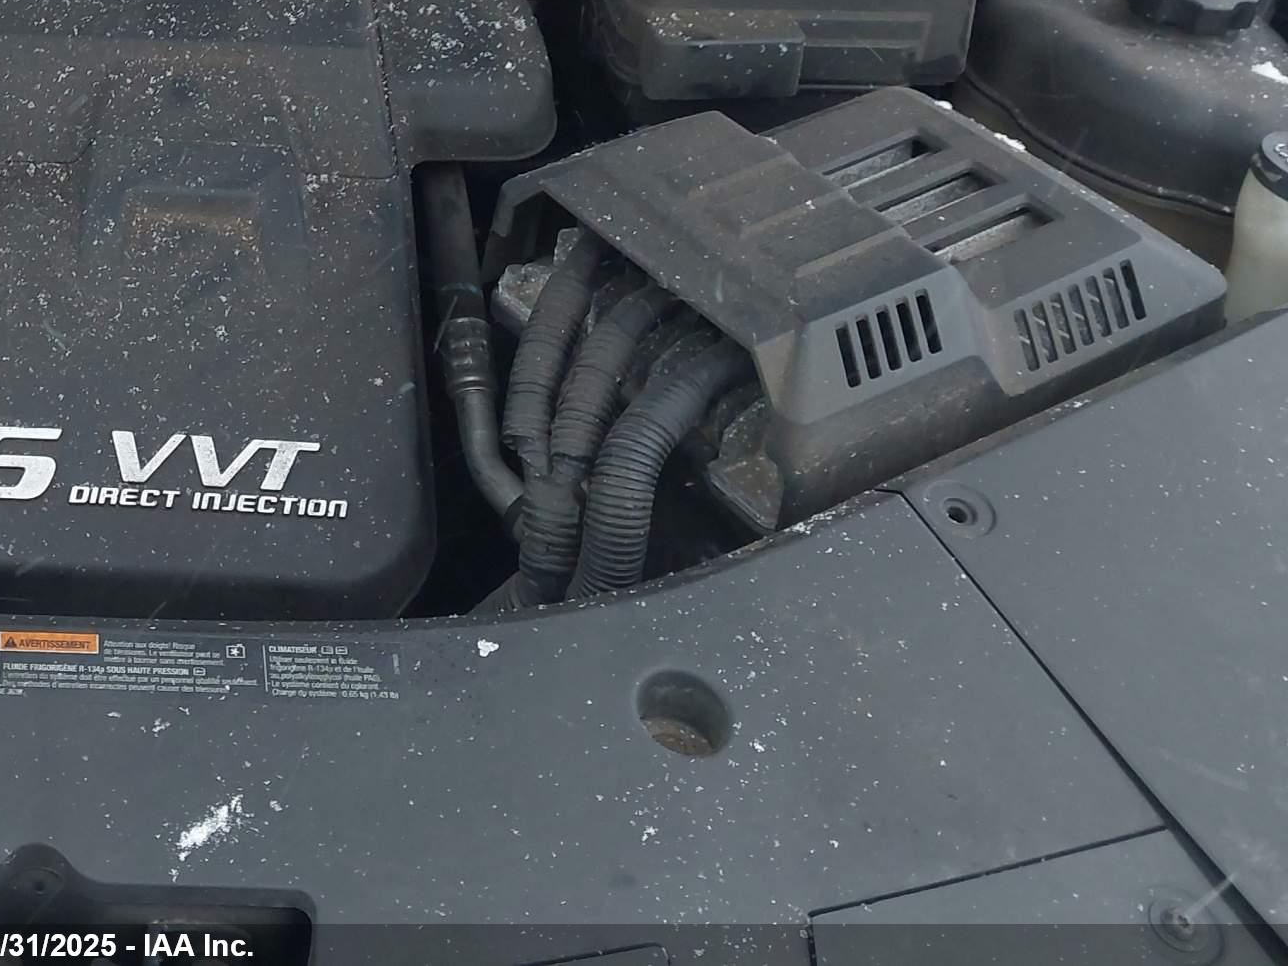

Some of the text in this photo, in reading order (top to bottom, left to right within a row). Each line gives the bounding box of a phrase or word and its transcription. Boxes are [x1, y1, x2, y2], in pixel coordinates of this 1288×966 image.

[112, 430, 321, 491] VVT
[68, 484, 348, 518] DIRECT INJECTION
[18, 639, 91, 649] AVERTISSEMENT
[106, 665, 126, 674] SOUS
[152, 667, 189, 676] PRESSION
